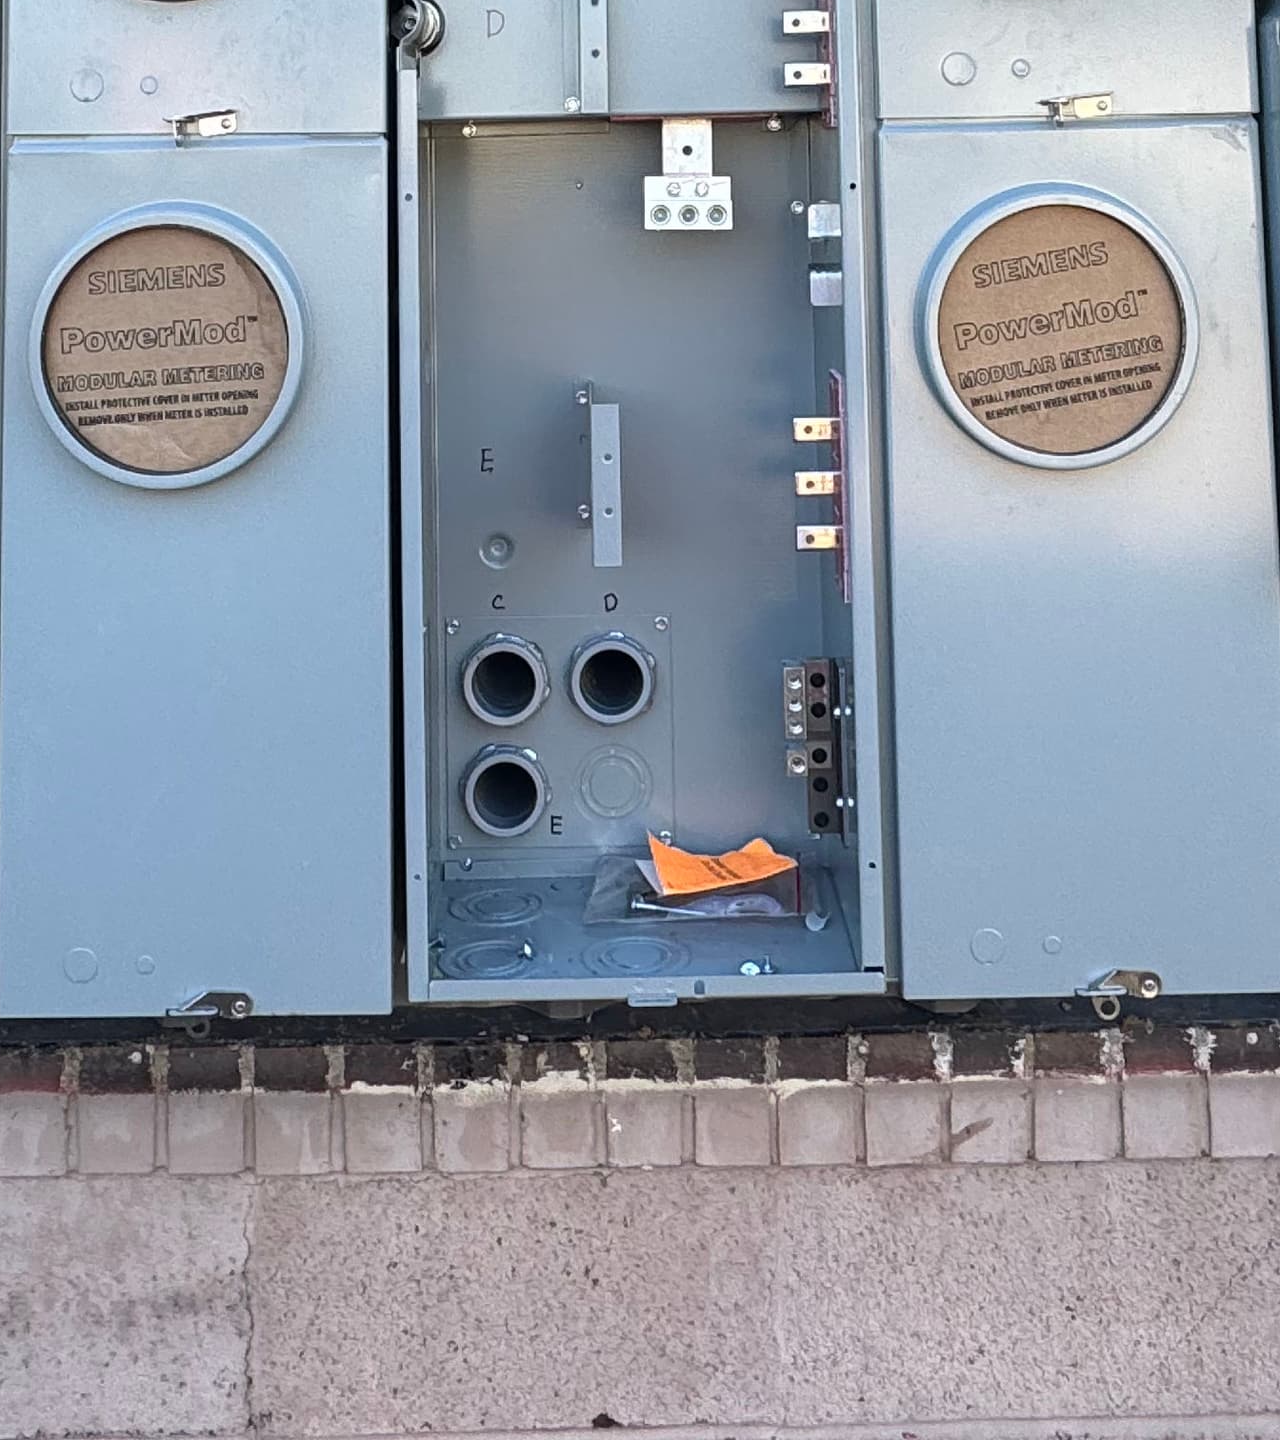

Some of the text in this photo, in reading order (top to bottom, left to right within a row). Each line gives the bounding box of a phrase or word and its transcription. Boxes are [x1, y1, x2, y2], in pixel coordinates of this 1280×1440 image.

[486, 9, 505, 38] D
[972, 241, 1109, 288] SIEMENS
[88, 263, 225, 295] SIEMENS
[958, 335, 1163, 390] MODULAR METERING
[57, 363, 264, 392] MODULAR METERING
[1056, 377, 1082, 390] COVER
[153, 395, 179, 404] COVER
[491, 594, 505, 611] C
[604, 593, 618, 612] D
[550, 815, 563, 835] E
